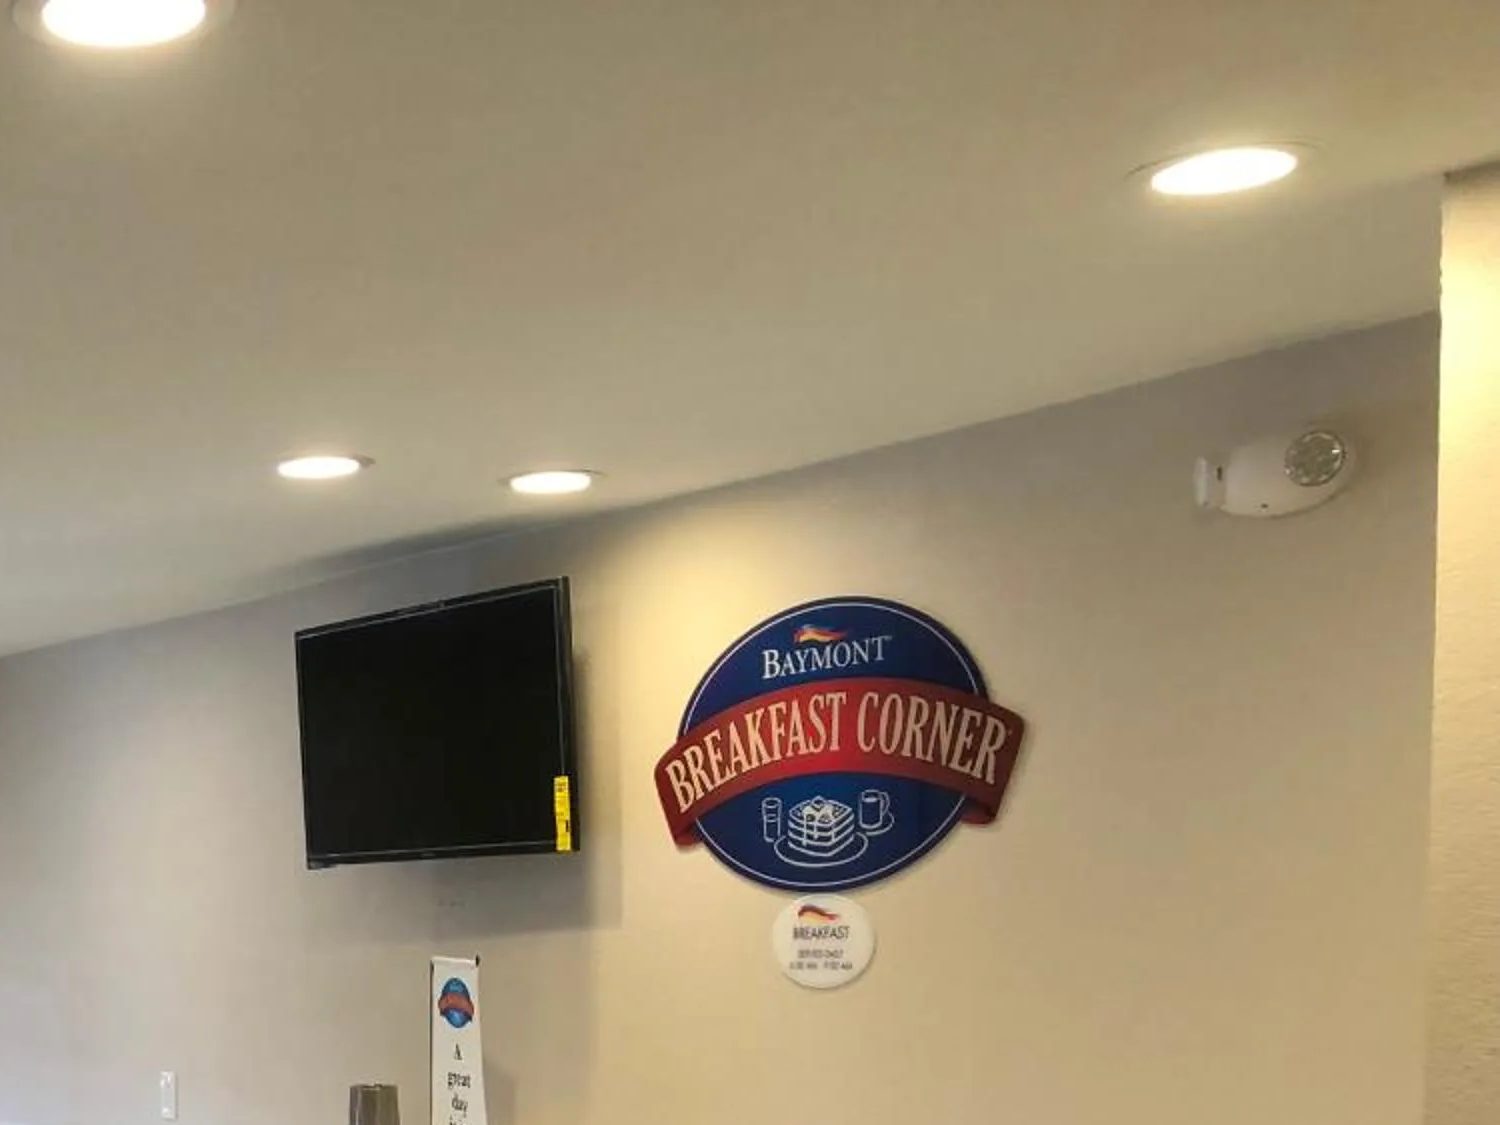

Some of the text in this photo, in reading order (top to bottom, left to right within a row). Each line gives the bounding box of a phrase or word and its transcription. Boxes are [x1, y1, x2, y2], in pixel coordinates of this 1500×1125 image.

[762, 635, 888, 679] BAYMONT
[664, 692, 847, 814] BREAKFAST
[857, 692, 1007, 785] CORNER
[793, 925, 850, 941] BREAKFAST
[453, 1043, 462, 1060] A
[447, 1071, 471, 1090] great
[452, 1092, 468, 1118] day
